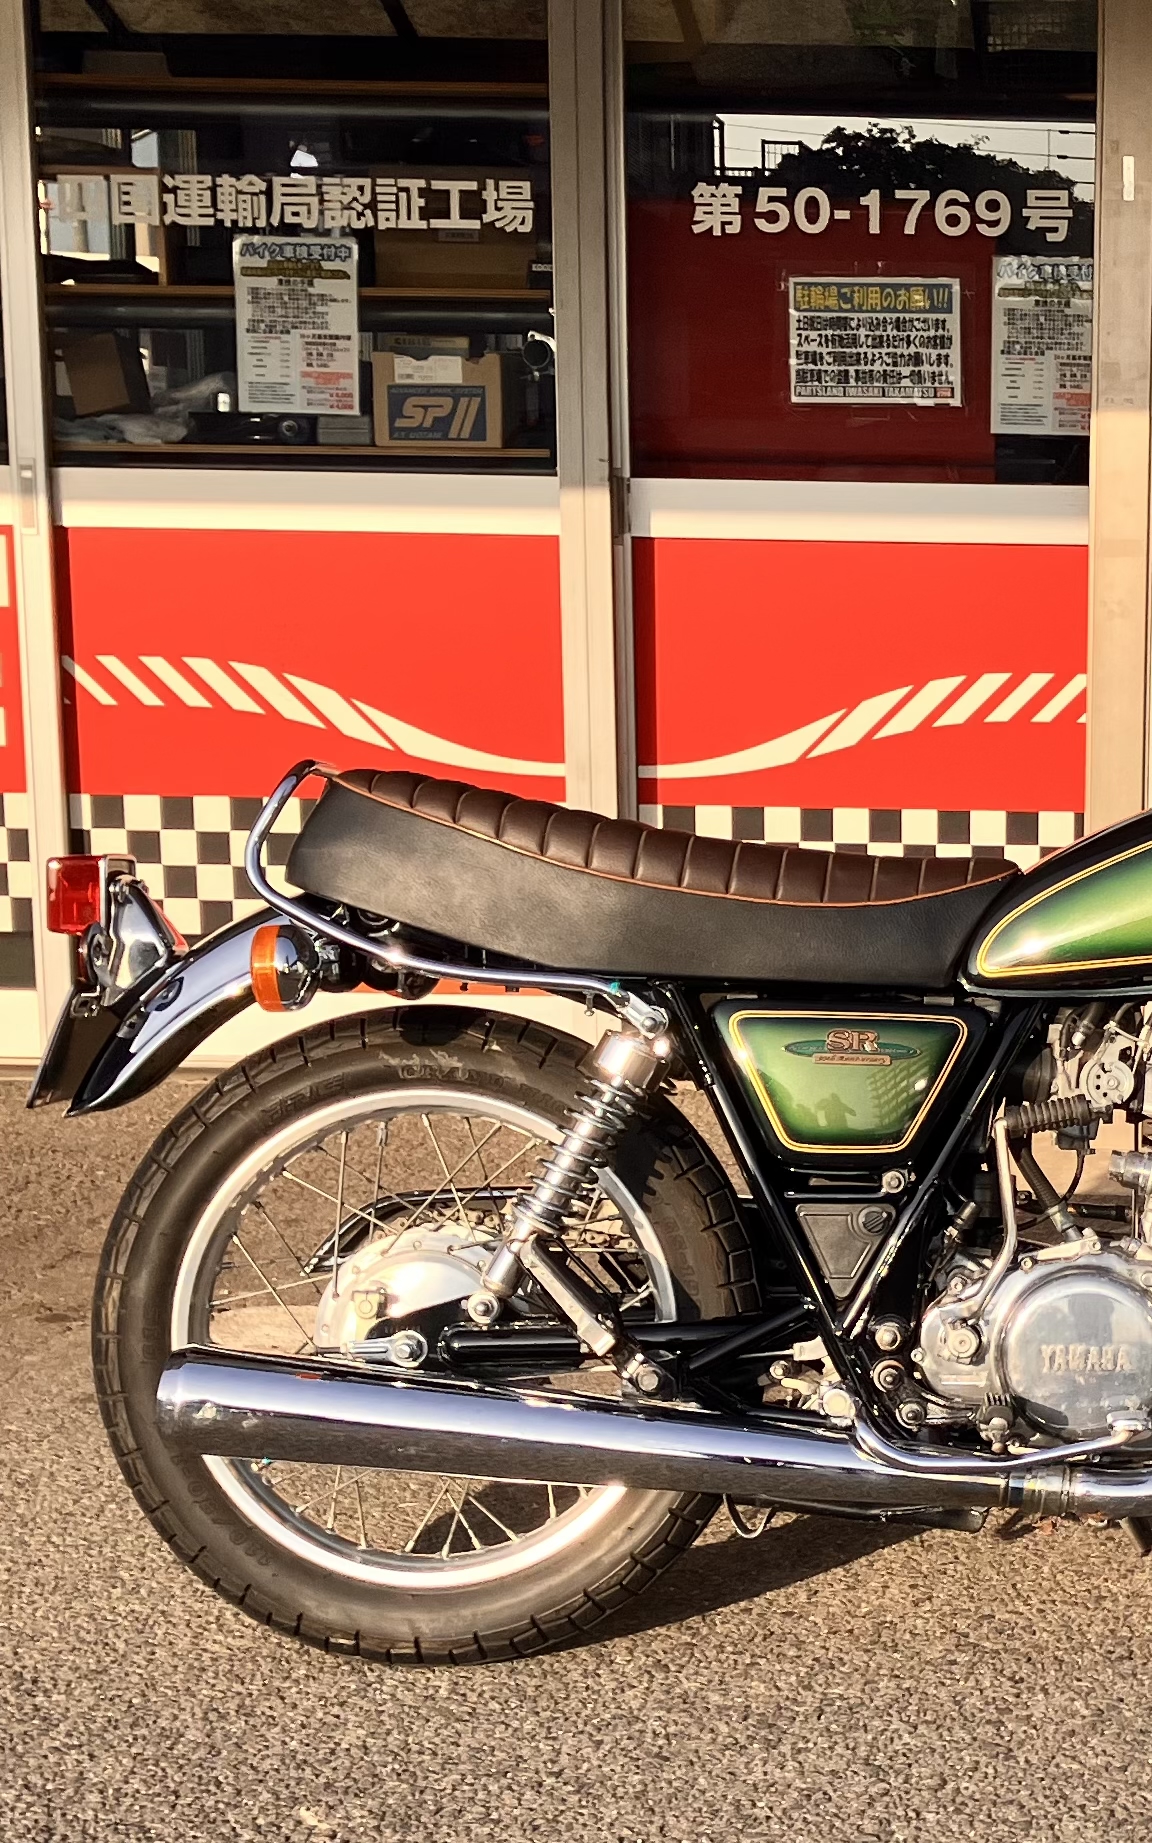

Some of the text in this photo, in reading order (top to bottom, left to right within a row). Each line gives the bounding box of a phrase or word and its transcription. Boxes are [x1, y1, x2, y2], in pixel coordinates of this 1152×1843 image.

[57, 174, 535, 233] 四国運輸局認証工場
[690, 182, 1074, 243] 第50-1769号
[826, 1029, 879, 1052] SR
[1041, 1344, 1132, 1374] YAMAHA
